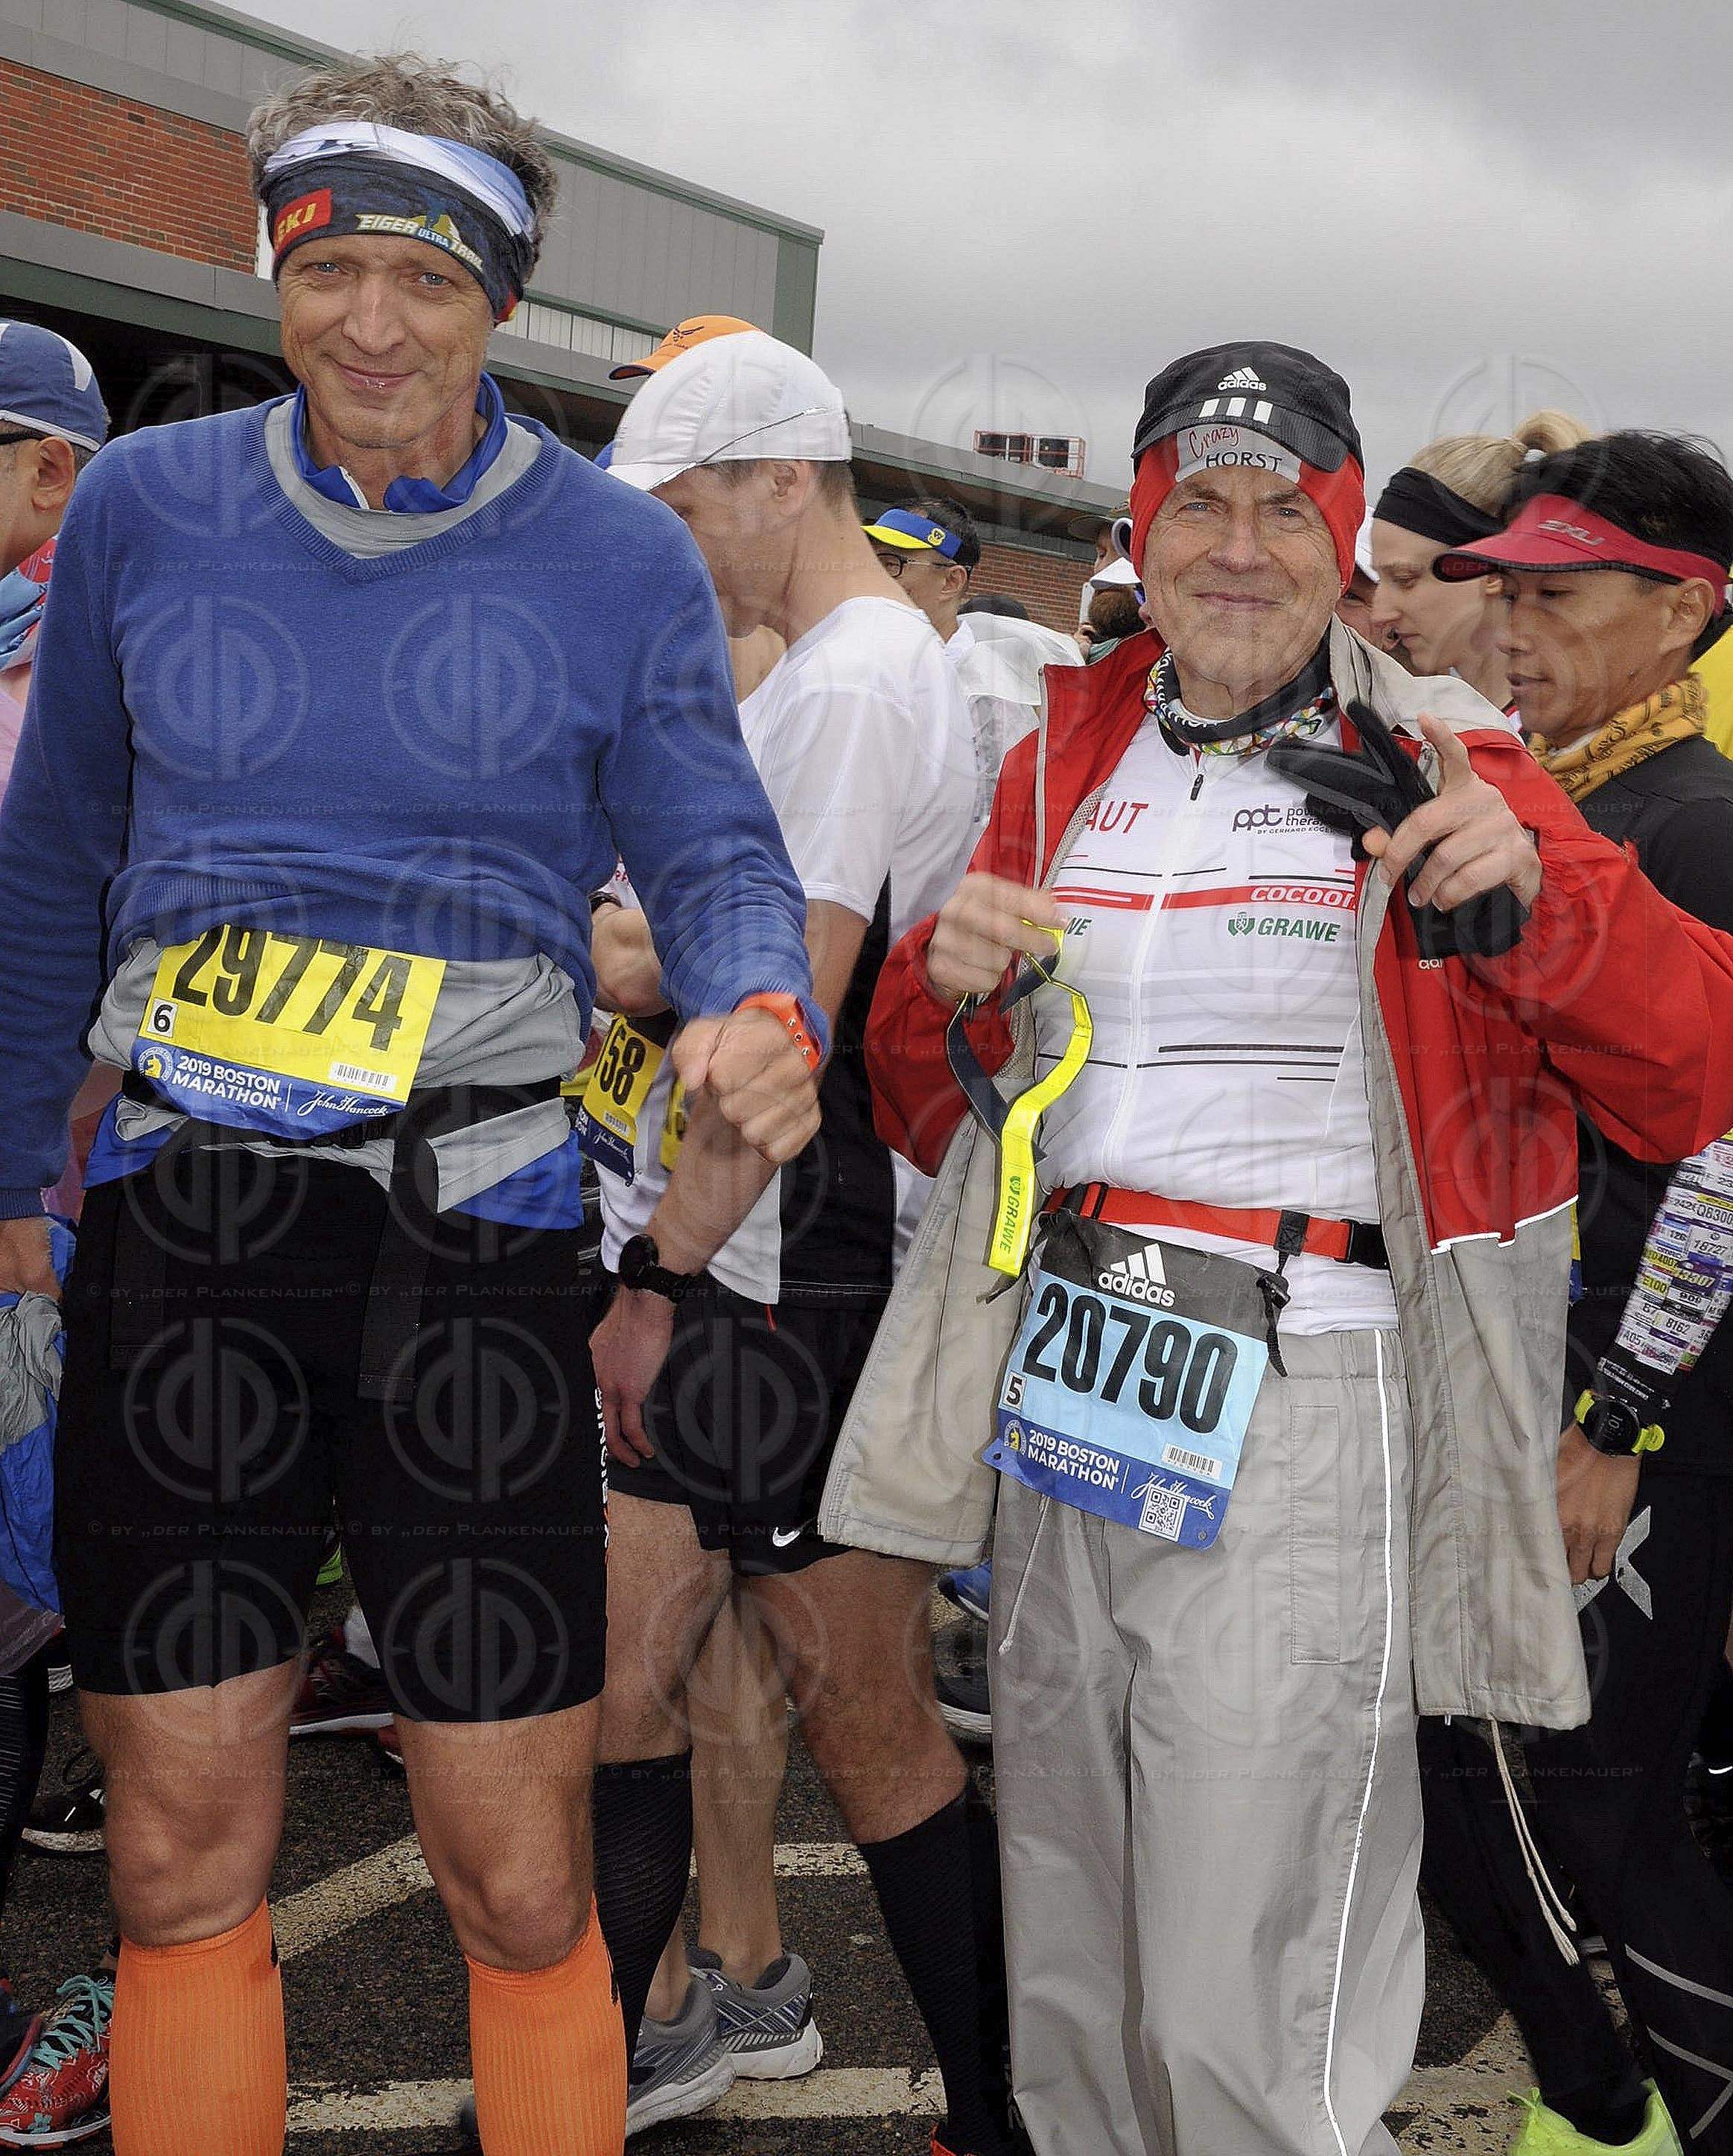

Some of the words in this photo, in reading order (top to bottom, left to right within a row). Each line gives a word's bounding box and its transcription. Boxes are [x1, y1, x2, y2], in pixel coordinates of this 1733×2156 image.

[357, 213, 419, 235] EIGER
[418, 227, 450, 247] ULTRA
[1218, 379, 1267, 392] adidas
[1206, 451, 1282, 473] HORST
[1258, 918, 1341, 942] GRAWE
[172, 924, 413, 1052] 29774
[153, 1004, 174, 1033] 6
[176, 1055, 212, 1078] 2019
[213, 1065, 281, 1094] BOSTON
[1000, 1195, 1020, 1254] GRAWE
[1098, 1269, 1176, 1307] adidas
[1022, 1282, 1238, 1434] 20790
[1006, 1377, 1024, 1405] 5
[1028, 1429, 1057, 1451] 2019
[1057, 1440, 1121, 1475] BOSTON
